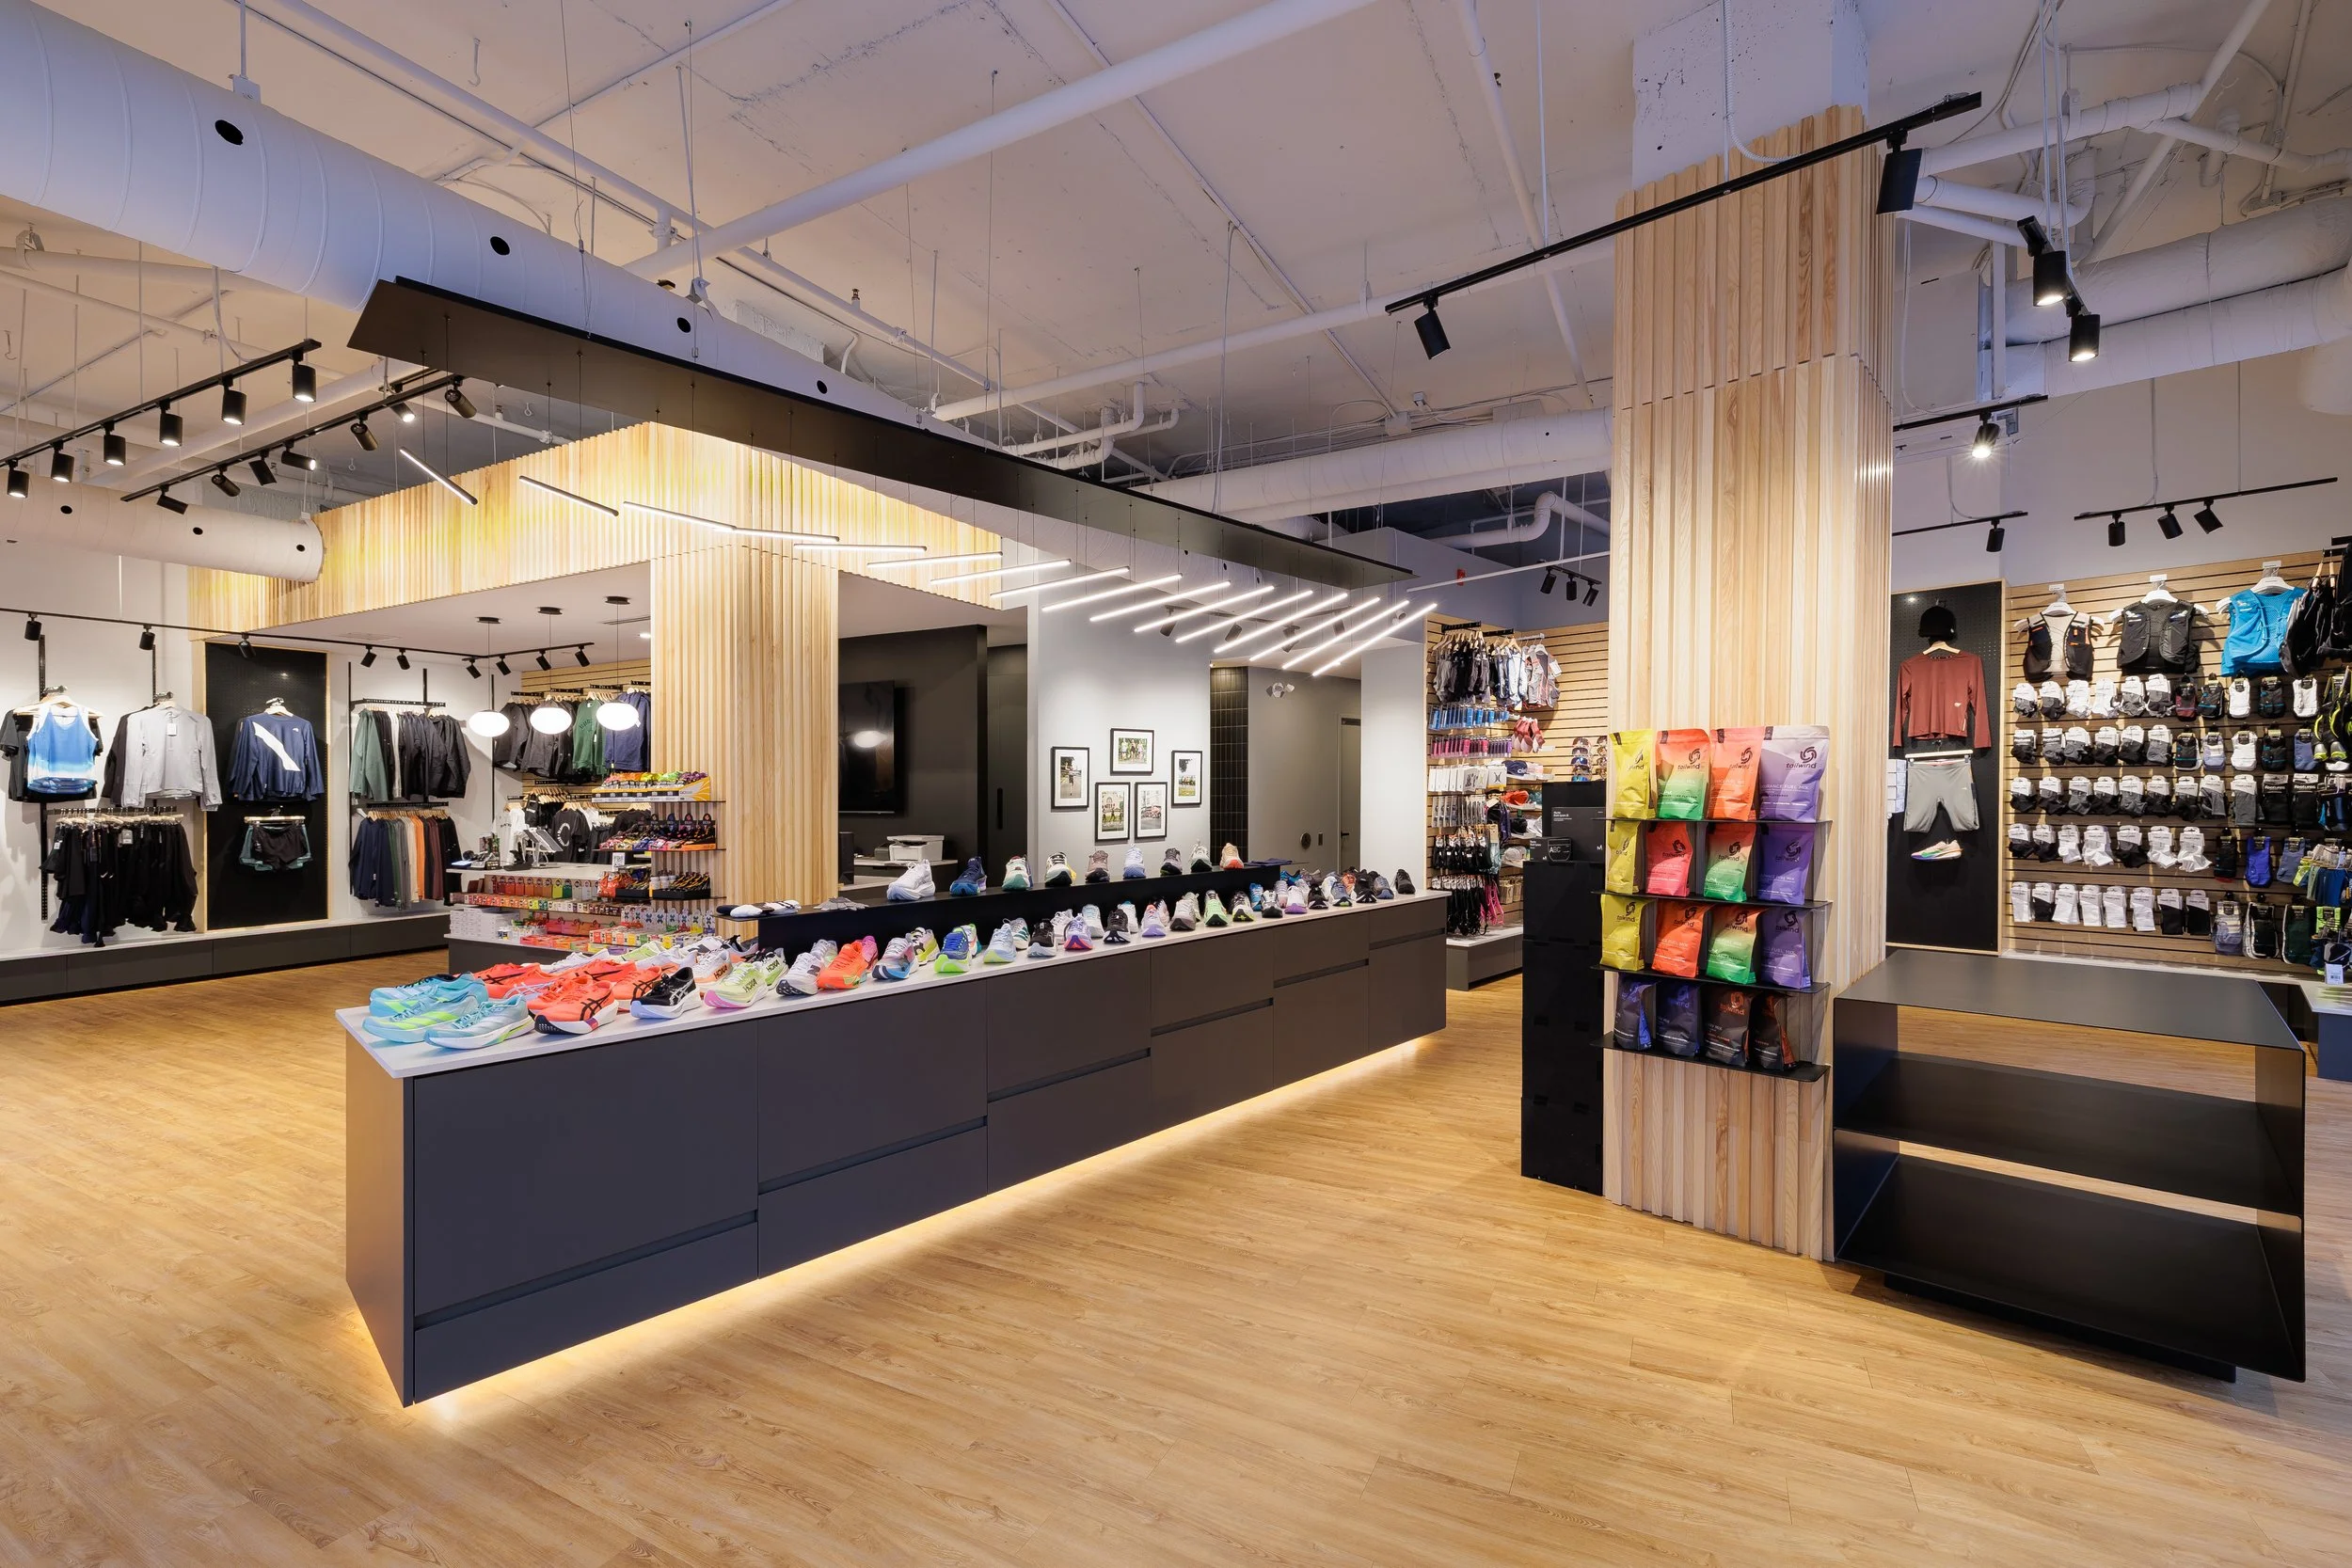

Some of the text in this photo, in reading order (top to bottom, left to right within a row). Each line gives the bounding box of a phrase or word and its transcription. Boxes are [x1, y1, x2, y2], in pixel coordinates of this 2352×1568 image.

[1729, 761, 1750, 769] tailwind
[713, 964, 728, 979] HOKA
[766, 958, 780, 973] HOKA
[742, 978, 758, 993] HOKA
